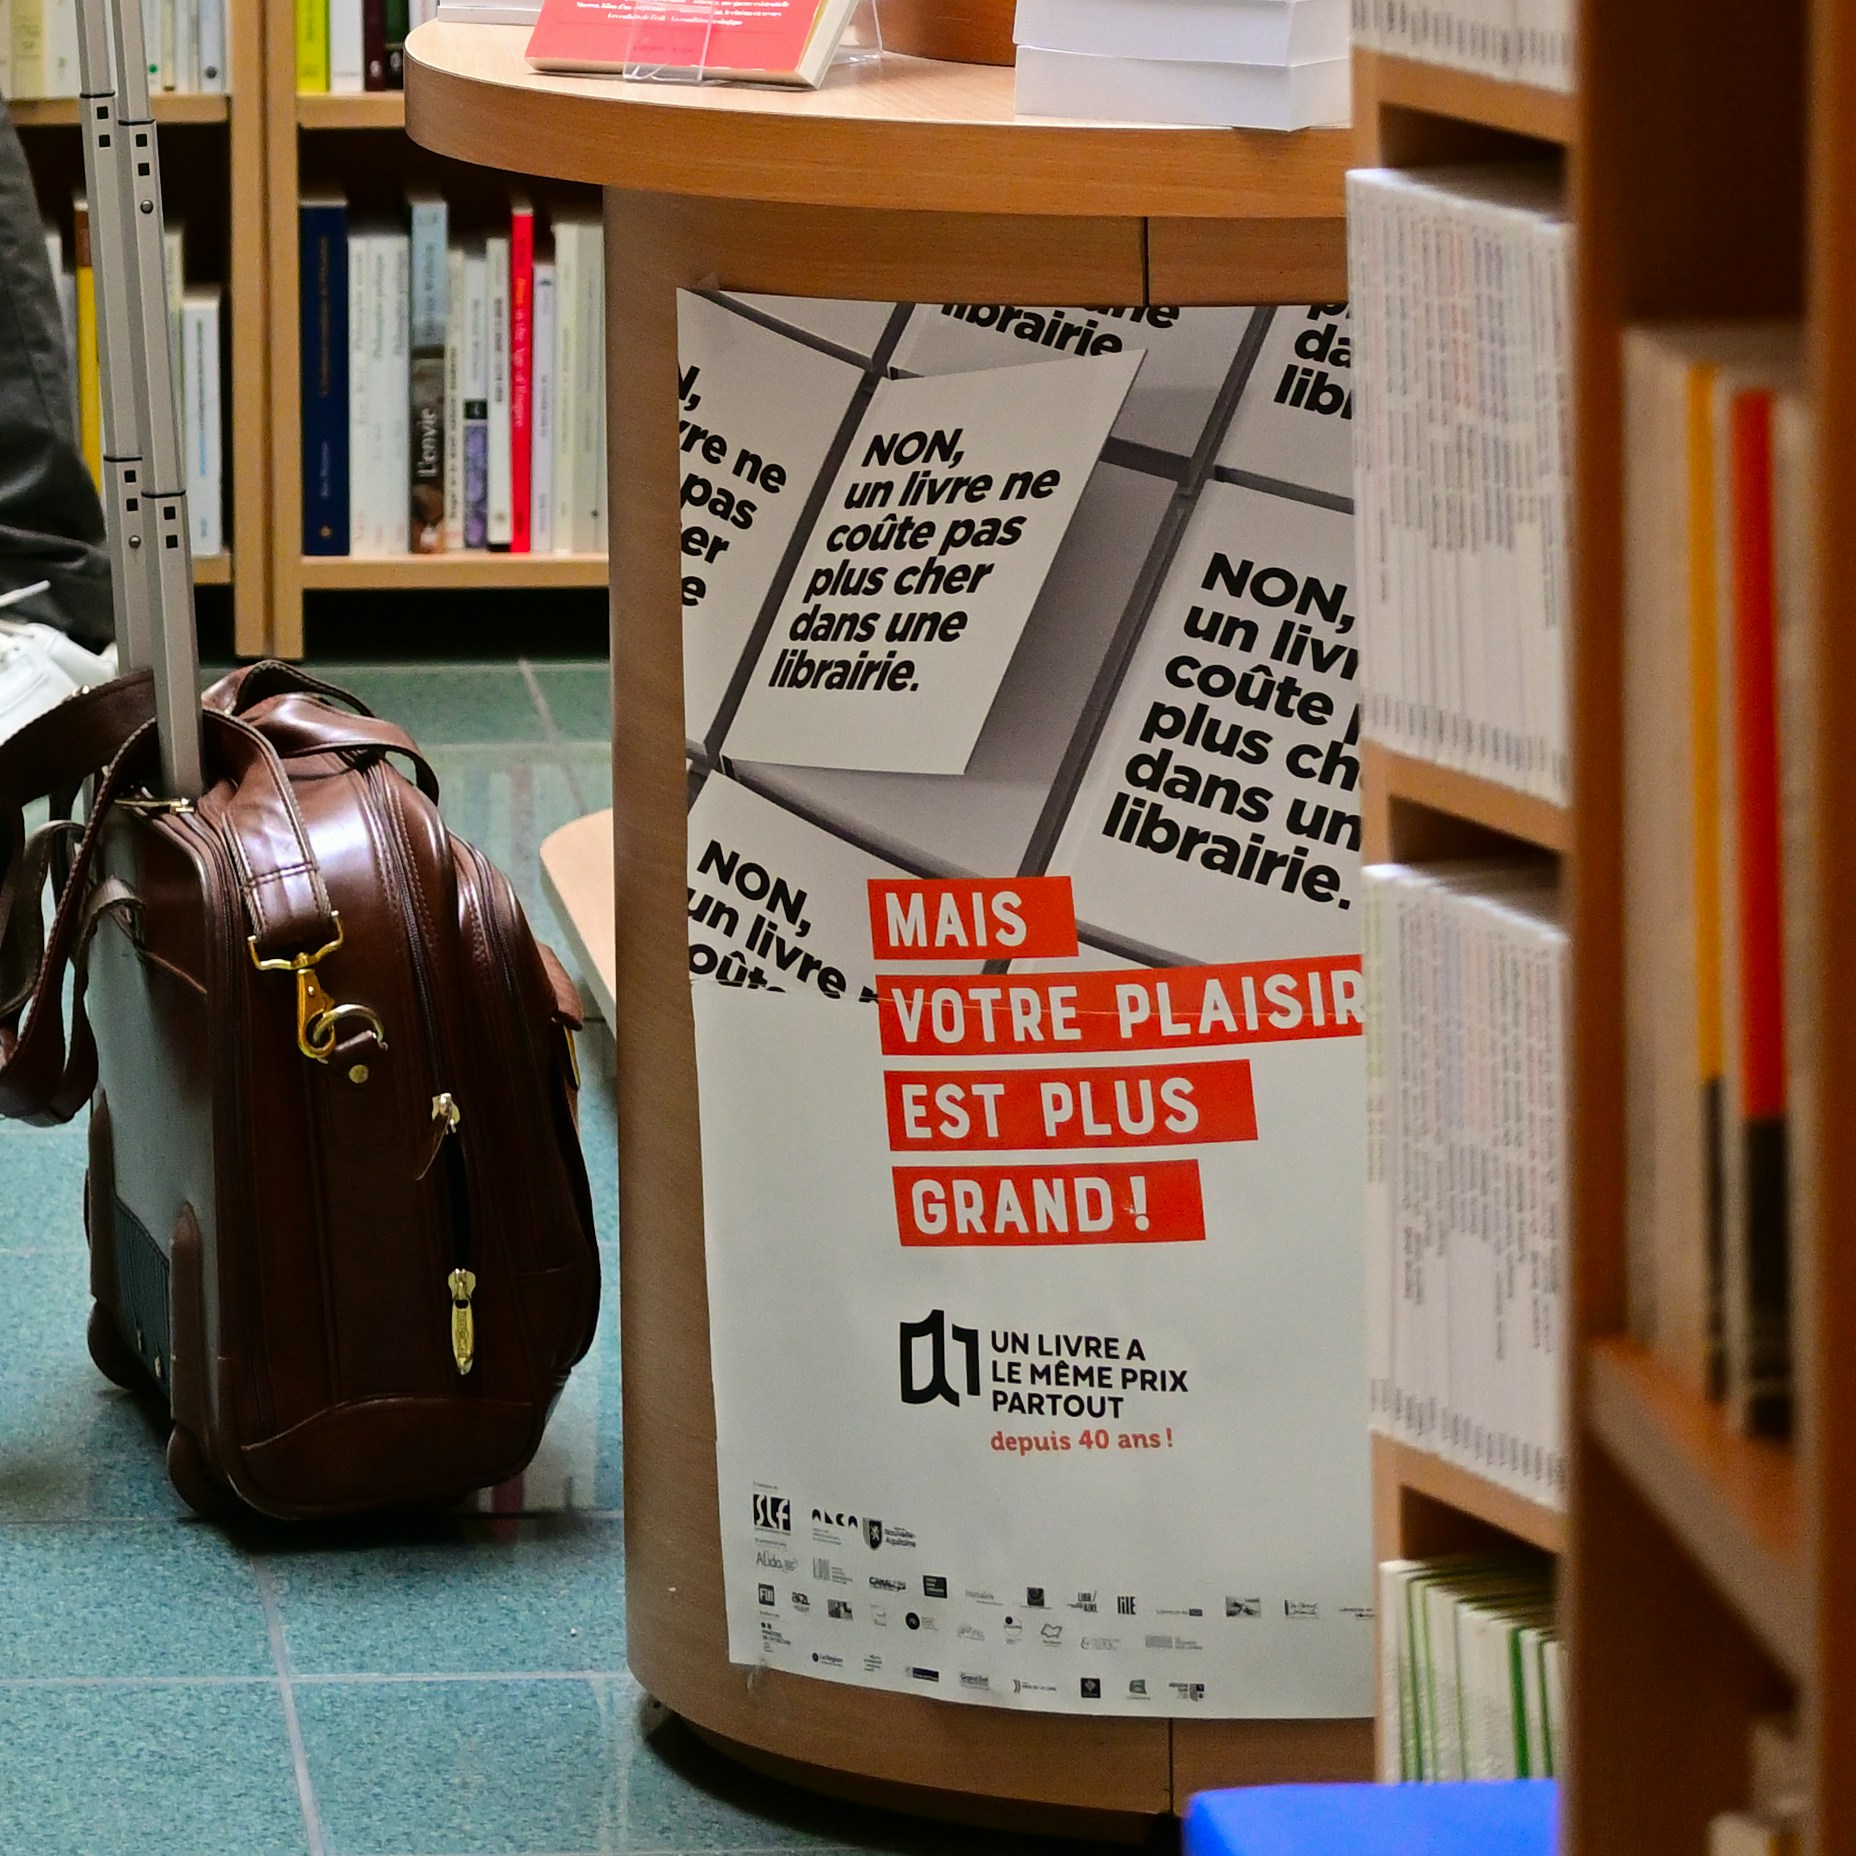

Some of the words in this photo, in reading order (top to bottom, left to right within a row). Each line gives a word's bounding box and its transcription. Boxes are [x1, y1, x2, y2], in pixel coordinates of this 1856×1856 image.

[417, 406, 439, 479] L'envie
[861, 428, 966, 469] NON,
[732, 447, 787, 494] ne
[843, 478, 894, 511] un
[898, 470, 994, 507] livre
[999, 466, 1062, 502] ne
[680, 472, 758, 531] pas
[825, 514, 937, 554] coûte
[938, 513, 1027, 557] pas
[802, 557, 887, 605] plus
[892, 557, 995, 596] cher
[1200, 552, 1356, 634] NON,
[787, 604, 882, 644] dans
[884, 608, 970, 643] une
[1183, 605, 1260, 654] un
[767, 648, 921, 693] librairie.
[1164, 654, 1335, 727] coûte
[1138, 700, 1274, 765] plus
[1124, 746, 1275, 824] dans
[1285, 797, 1363, 853] un
[1101, 791, 1352, 912] librairie.
[696, 838, 812, 938] NON,
[688, 886, 740, 939] un
[744, 913, 847, 1000] livre
[884, 889, 1028, 950] MAIS
[688, 943, 787, 994] oût
[889, 982, 1085, 1047] VOTRE
[1118, 968, 1366, 1042] PLAISIR
[903, 1084, 1006, 1140] EST
[1042, 1078, 1201, 1138] PLUS
[990, 1330, 1029, 1355] UN
[1037, 1334, 1121, 1360] LIVRE
[1126, 1339, 1147, 1361] A
[991, 1360, 1022, 1385] LE
[1030, 1360, 1113, 1390] MÊME
[1121, 1368, 1189, 1393] PRIX
[992, 1389, 1125, 1419] PARTOUT
[990, 1430, 1072, 1457] depuis
[1078, 1429, 1110, 1450] 40
